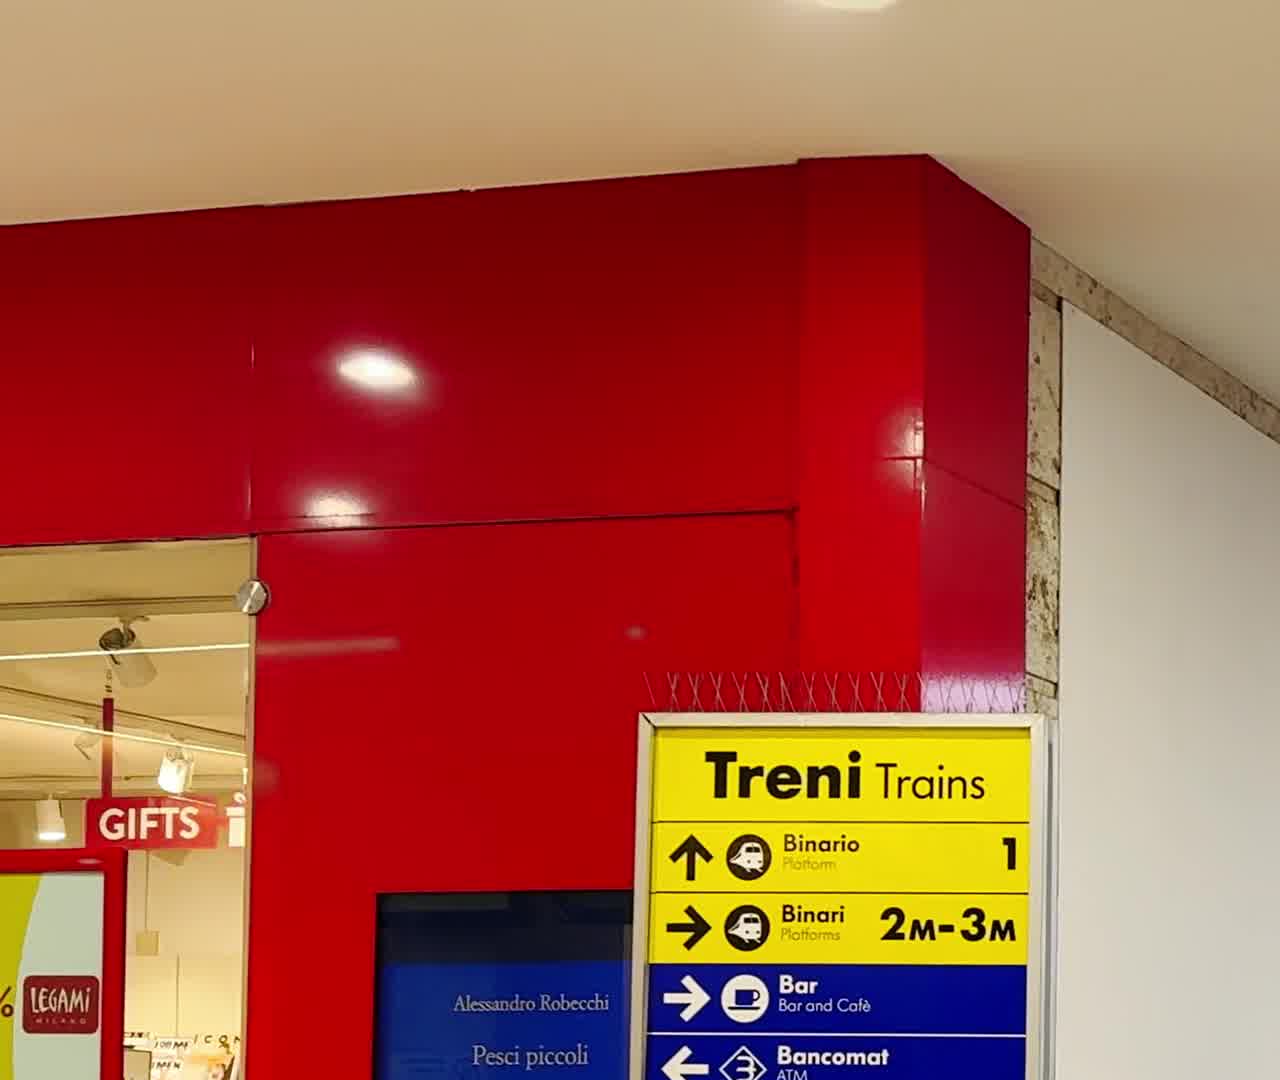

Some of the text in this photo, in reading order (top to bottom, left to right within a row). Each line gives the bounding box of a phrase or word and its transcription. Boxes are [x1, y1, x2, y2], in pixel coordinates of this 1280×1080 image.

[705, 750, 985, 799] Treni Trains
[99, 806, 200, 841] GIFTS
[783, 834, 859, 853] Binario
[1002, 837, 1017, 870] 1
[783, 857, 836, 871] Platform
[781, 905, 844, 923] Binari
[781, 928, 840, 942] Platforms
[779, 975, 818, 994] Bar
[454, 993, 609, 1012] Alessandro Robecchi
[779, 998, 871, 1012] Bar and Cafè
[472, 1043, 588, 1070] Pesci piccoli
[777, 1046, 889, 1066] Bancomat
